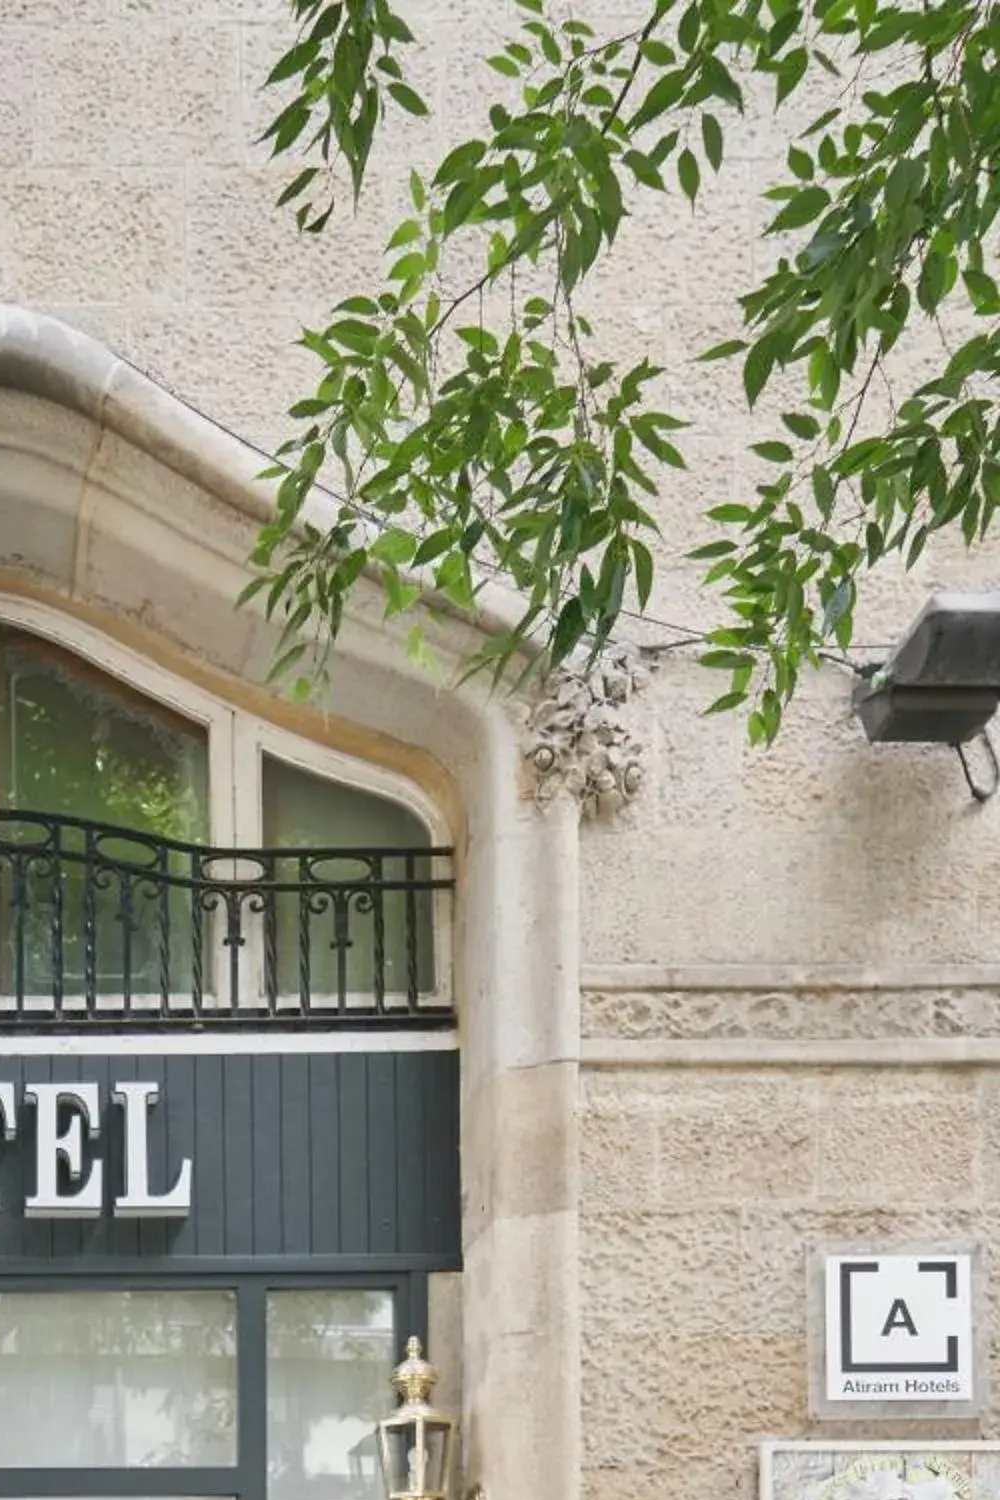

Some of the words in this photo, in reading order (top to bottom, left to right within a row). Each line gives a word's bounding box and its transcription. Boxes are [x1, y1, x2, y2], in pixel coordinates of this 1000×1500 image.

[880, 1298, 919, 1337] A
[842, 1379, 900, 1393] Atiram
[904, 1379, 961, 1393] Hotels
